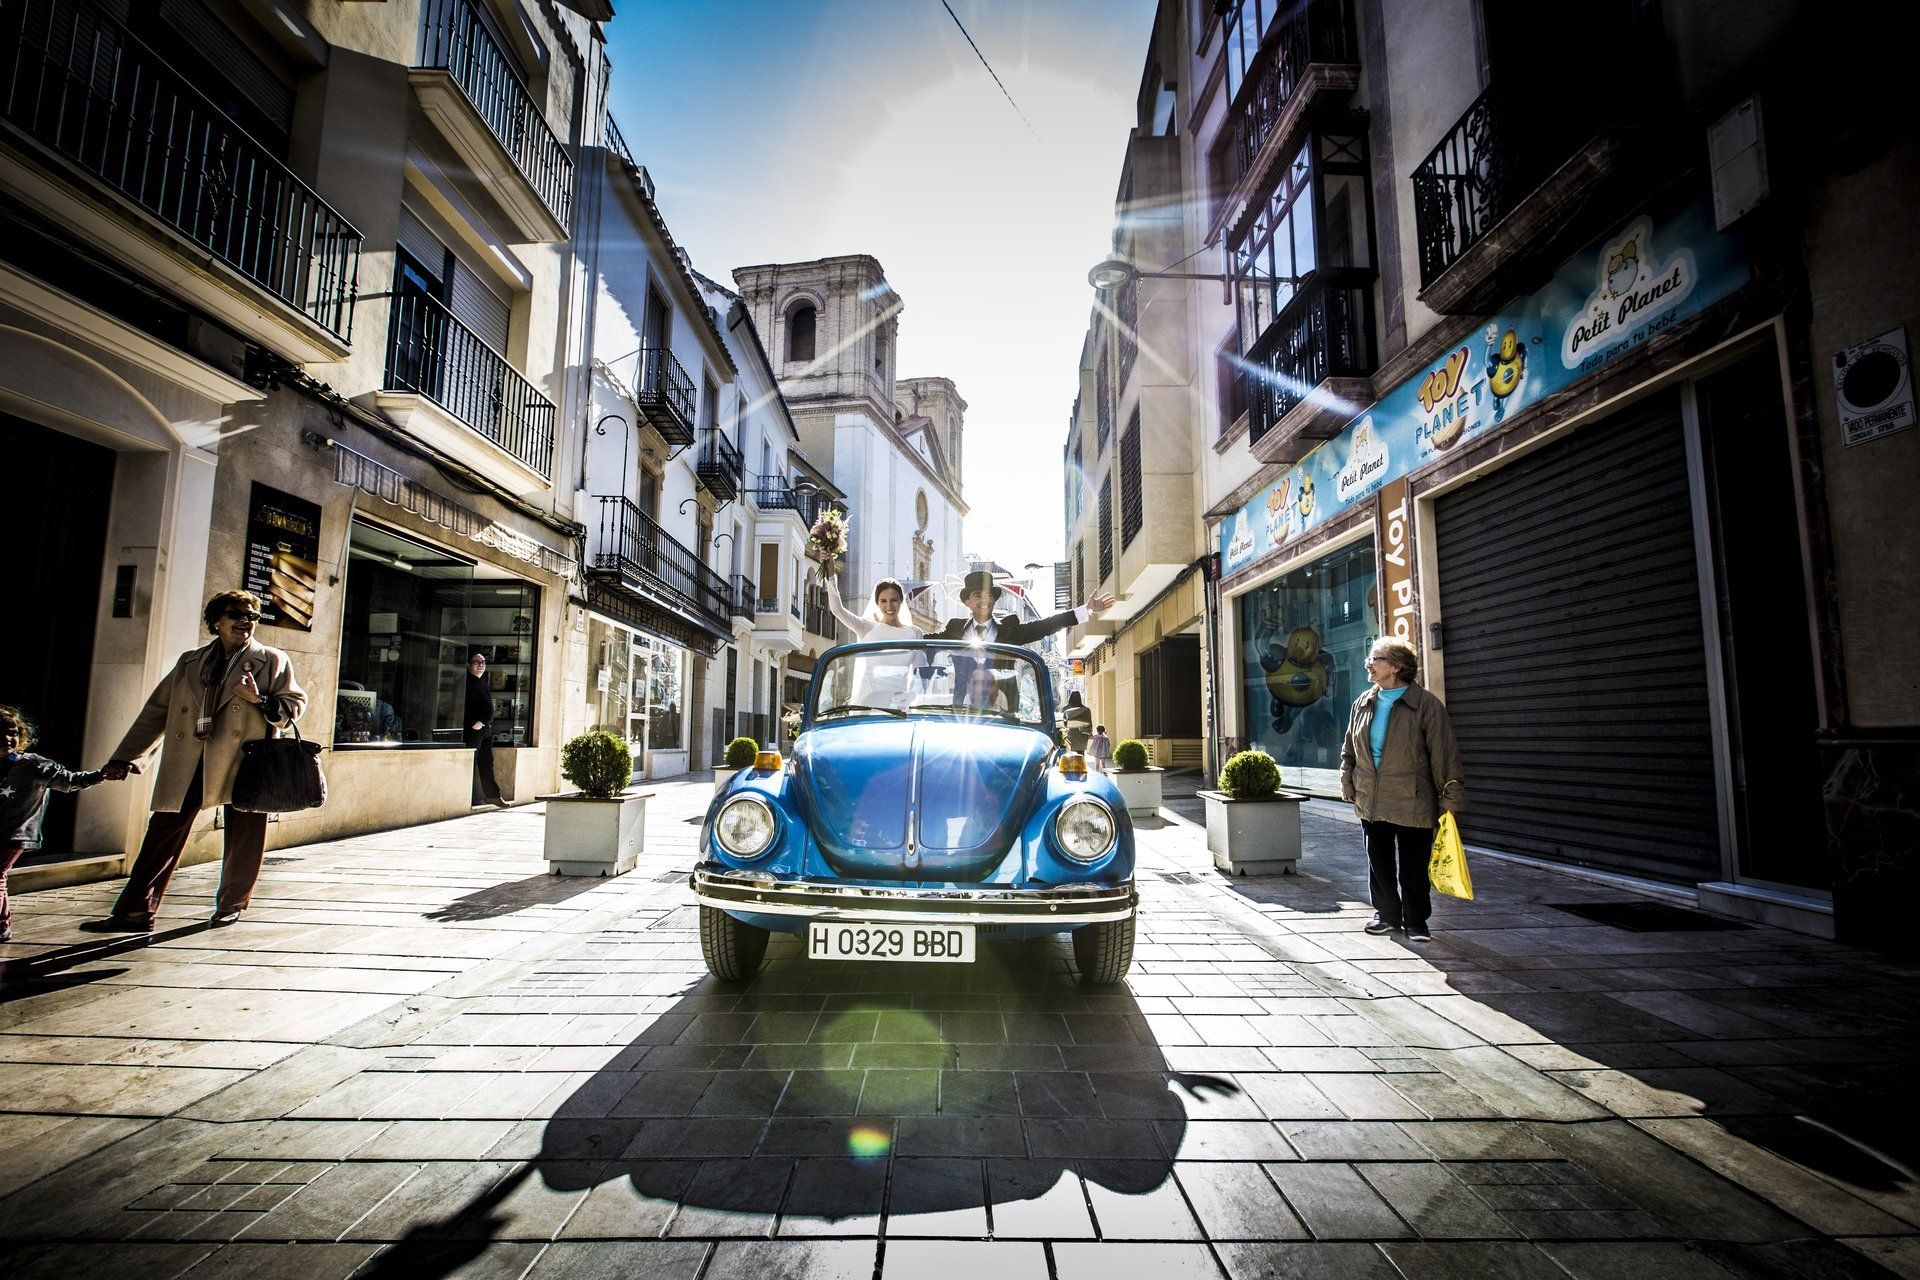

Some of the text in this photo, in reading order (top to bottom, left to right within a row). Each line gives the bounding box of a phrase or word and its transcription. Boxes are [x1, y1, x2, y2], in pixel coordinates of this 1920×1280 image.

[1572, 268, 1682, 352] Petit Planet
[1581, 309, 1677, 372] Todo para tu bebé
[1416, 379, 1485, 444] PLANET
[1417, 346, 1469, 413] TOY
[1267, 477, 1290, 517] TOY
[1341, 453, 1383, 492] Petit Planet
[1386, 497, 1415, 642] Toy Pla
[812, 927, 963, 958] H 0329 BBD
